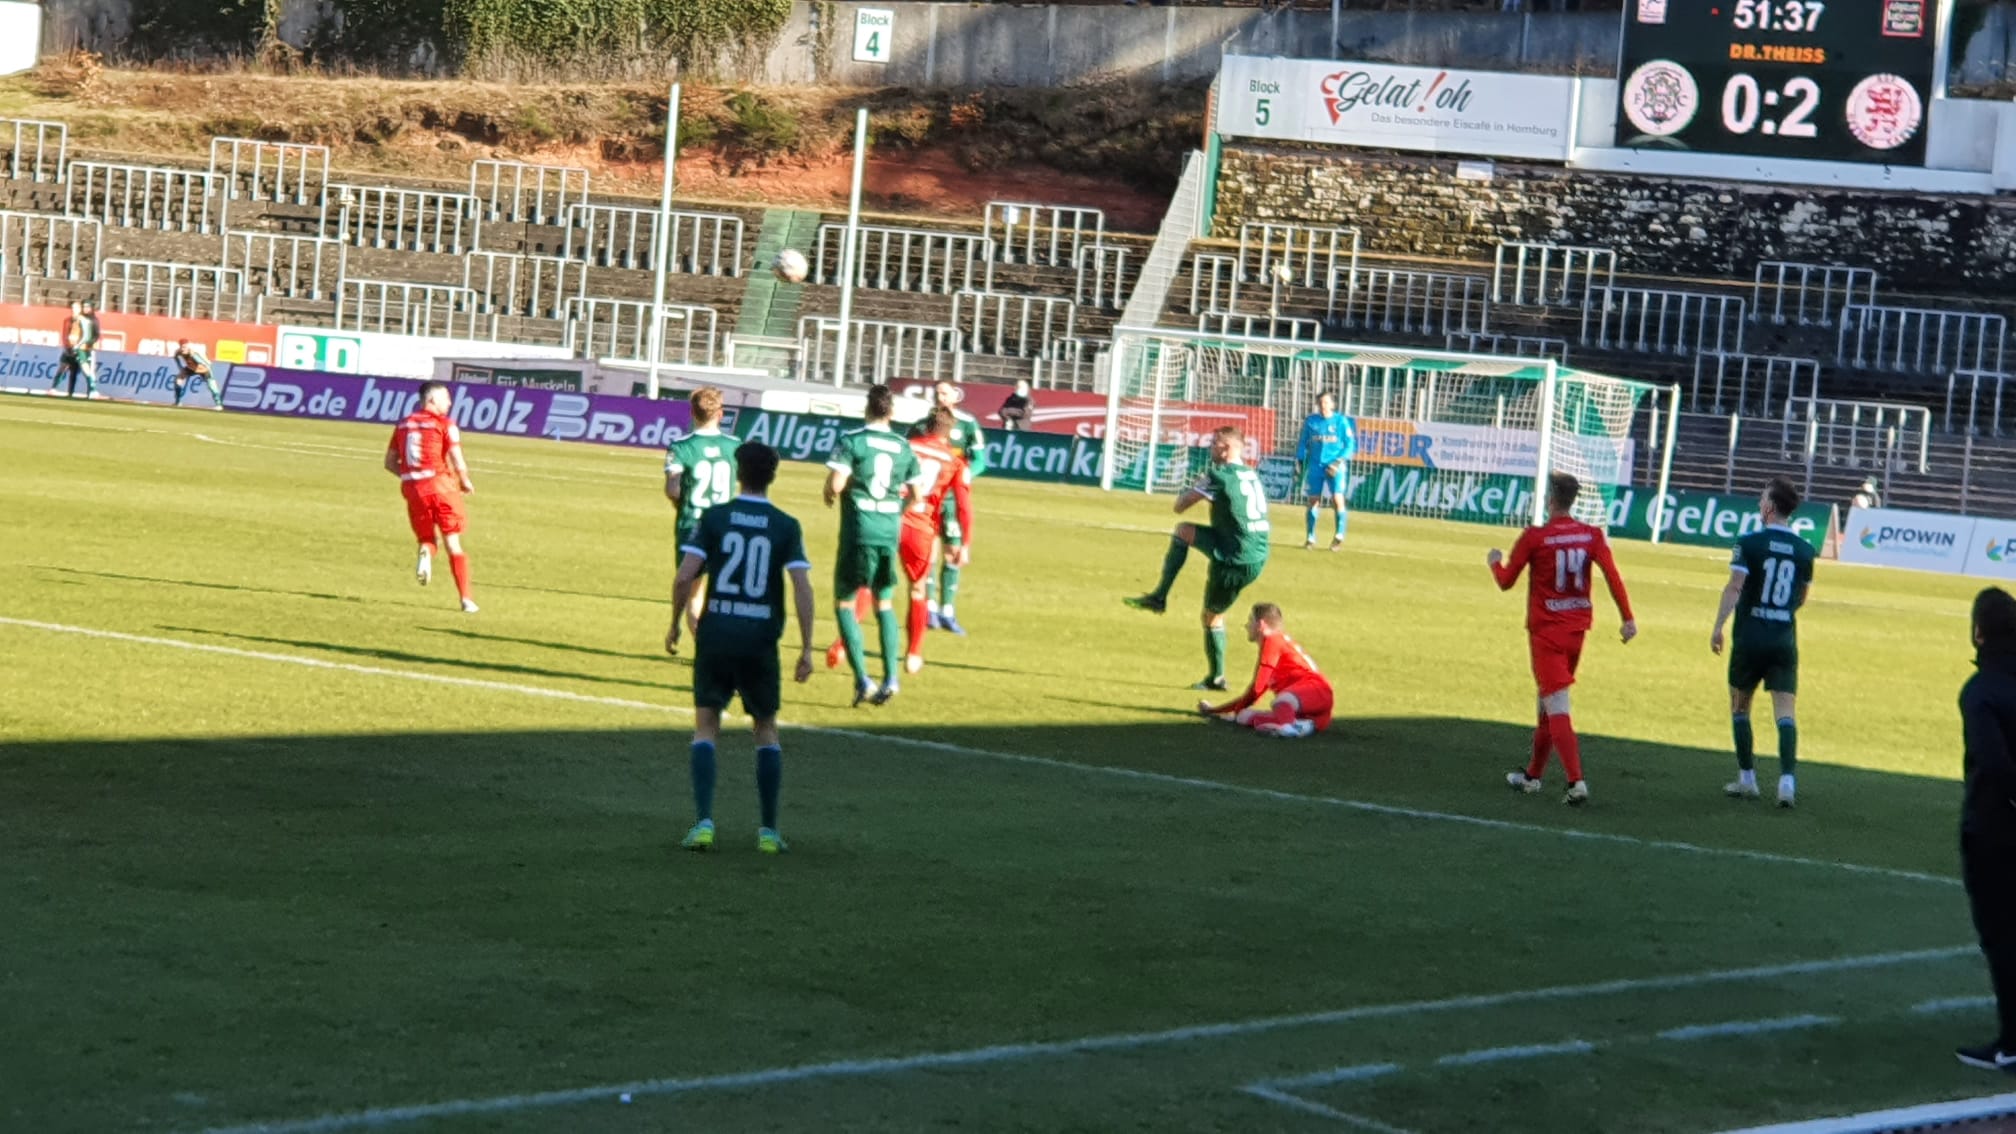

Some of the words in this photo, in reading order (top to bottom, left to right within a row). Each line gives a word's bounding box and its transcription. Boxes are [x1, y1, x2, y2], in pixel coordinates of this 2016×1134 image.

[860, 13, 889, 25] Block
[1733, 0, 1825, 32] 51:37
[866, 31, 880, 57] 4
[1249, 79, 1281, 94] Block
[1721, 73, 1820, 137] 0:2
[1255, 99, 1270, 126] 5
[1371, 112, 1392, 124] Das
[1394, 113, 1450, 129] besondere
[1494, 123, 1504, 132] in
[1507, 125, 1558, 138] Homburg
[355, 378, 535, 434] bucholz
[746, 412, 840, 460] Allgä
[691, 460, 731, 507] 29
[1645, 493, 1815, 540] Gelene
[716, 531, 771, 598] 20
[1555, 547, 1588, 593] 14
[1760, 557, 1796, 607] 18
